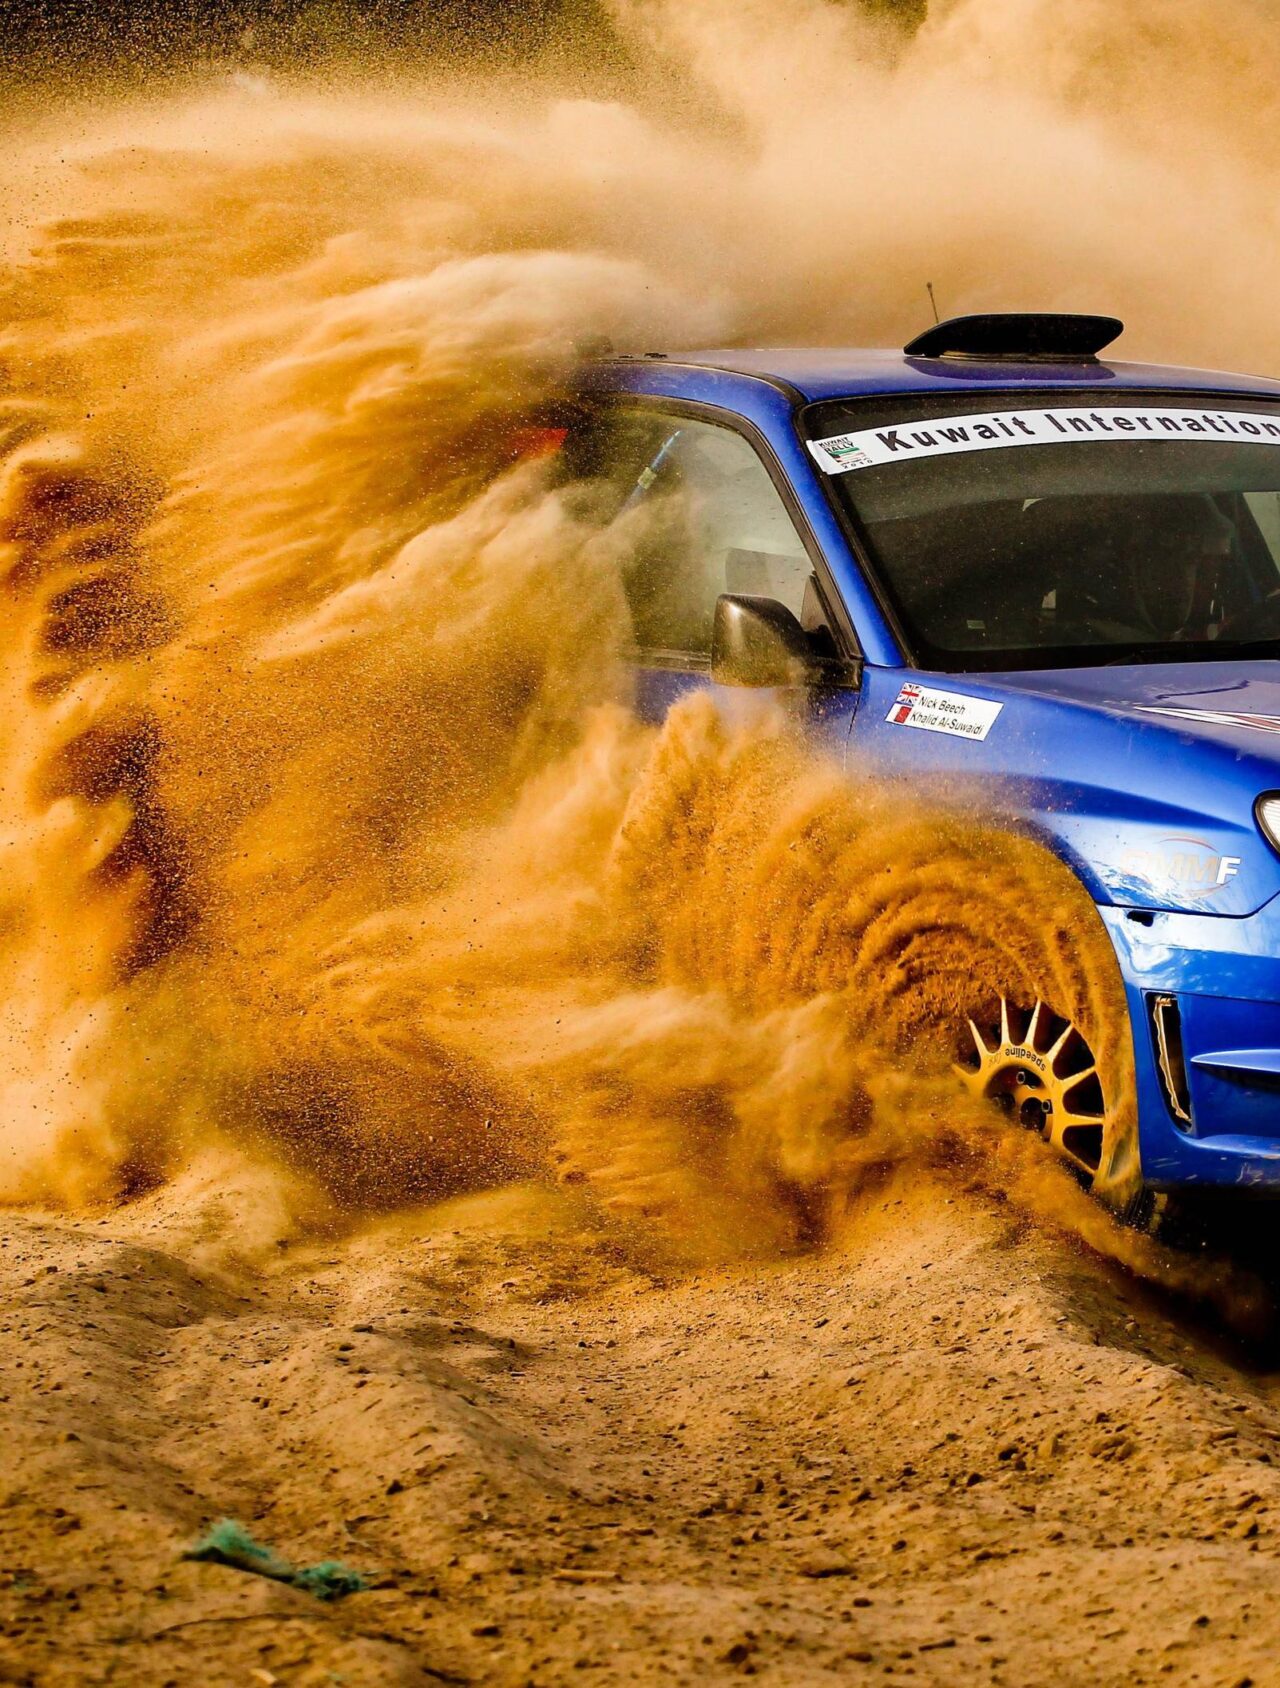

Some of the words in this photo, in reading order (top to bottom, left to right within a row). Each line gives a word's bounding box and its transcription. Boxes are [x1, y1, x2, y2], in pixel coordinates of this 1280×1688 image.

[818, 437, 849, 448] KUWAIT
[875, 416, 1035, 452] Kuwait
[824, 442, 855, 454] RALLY
[919, 696, 937, 709] Nick
[938, 700, 965, 715] Beech
[910, 711, 937, 726] Khalid
[938, 716, 983, 735] Al-Suwaidi
[1004, 1047, 1046, 1071] speedline
